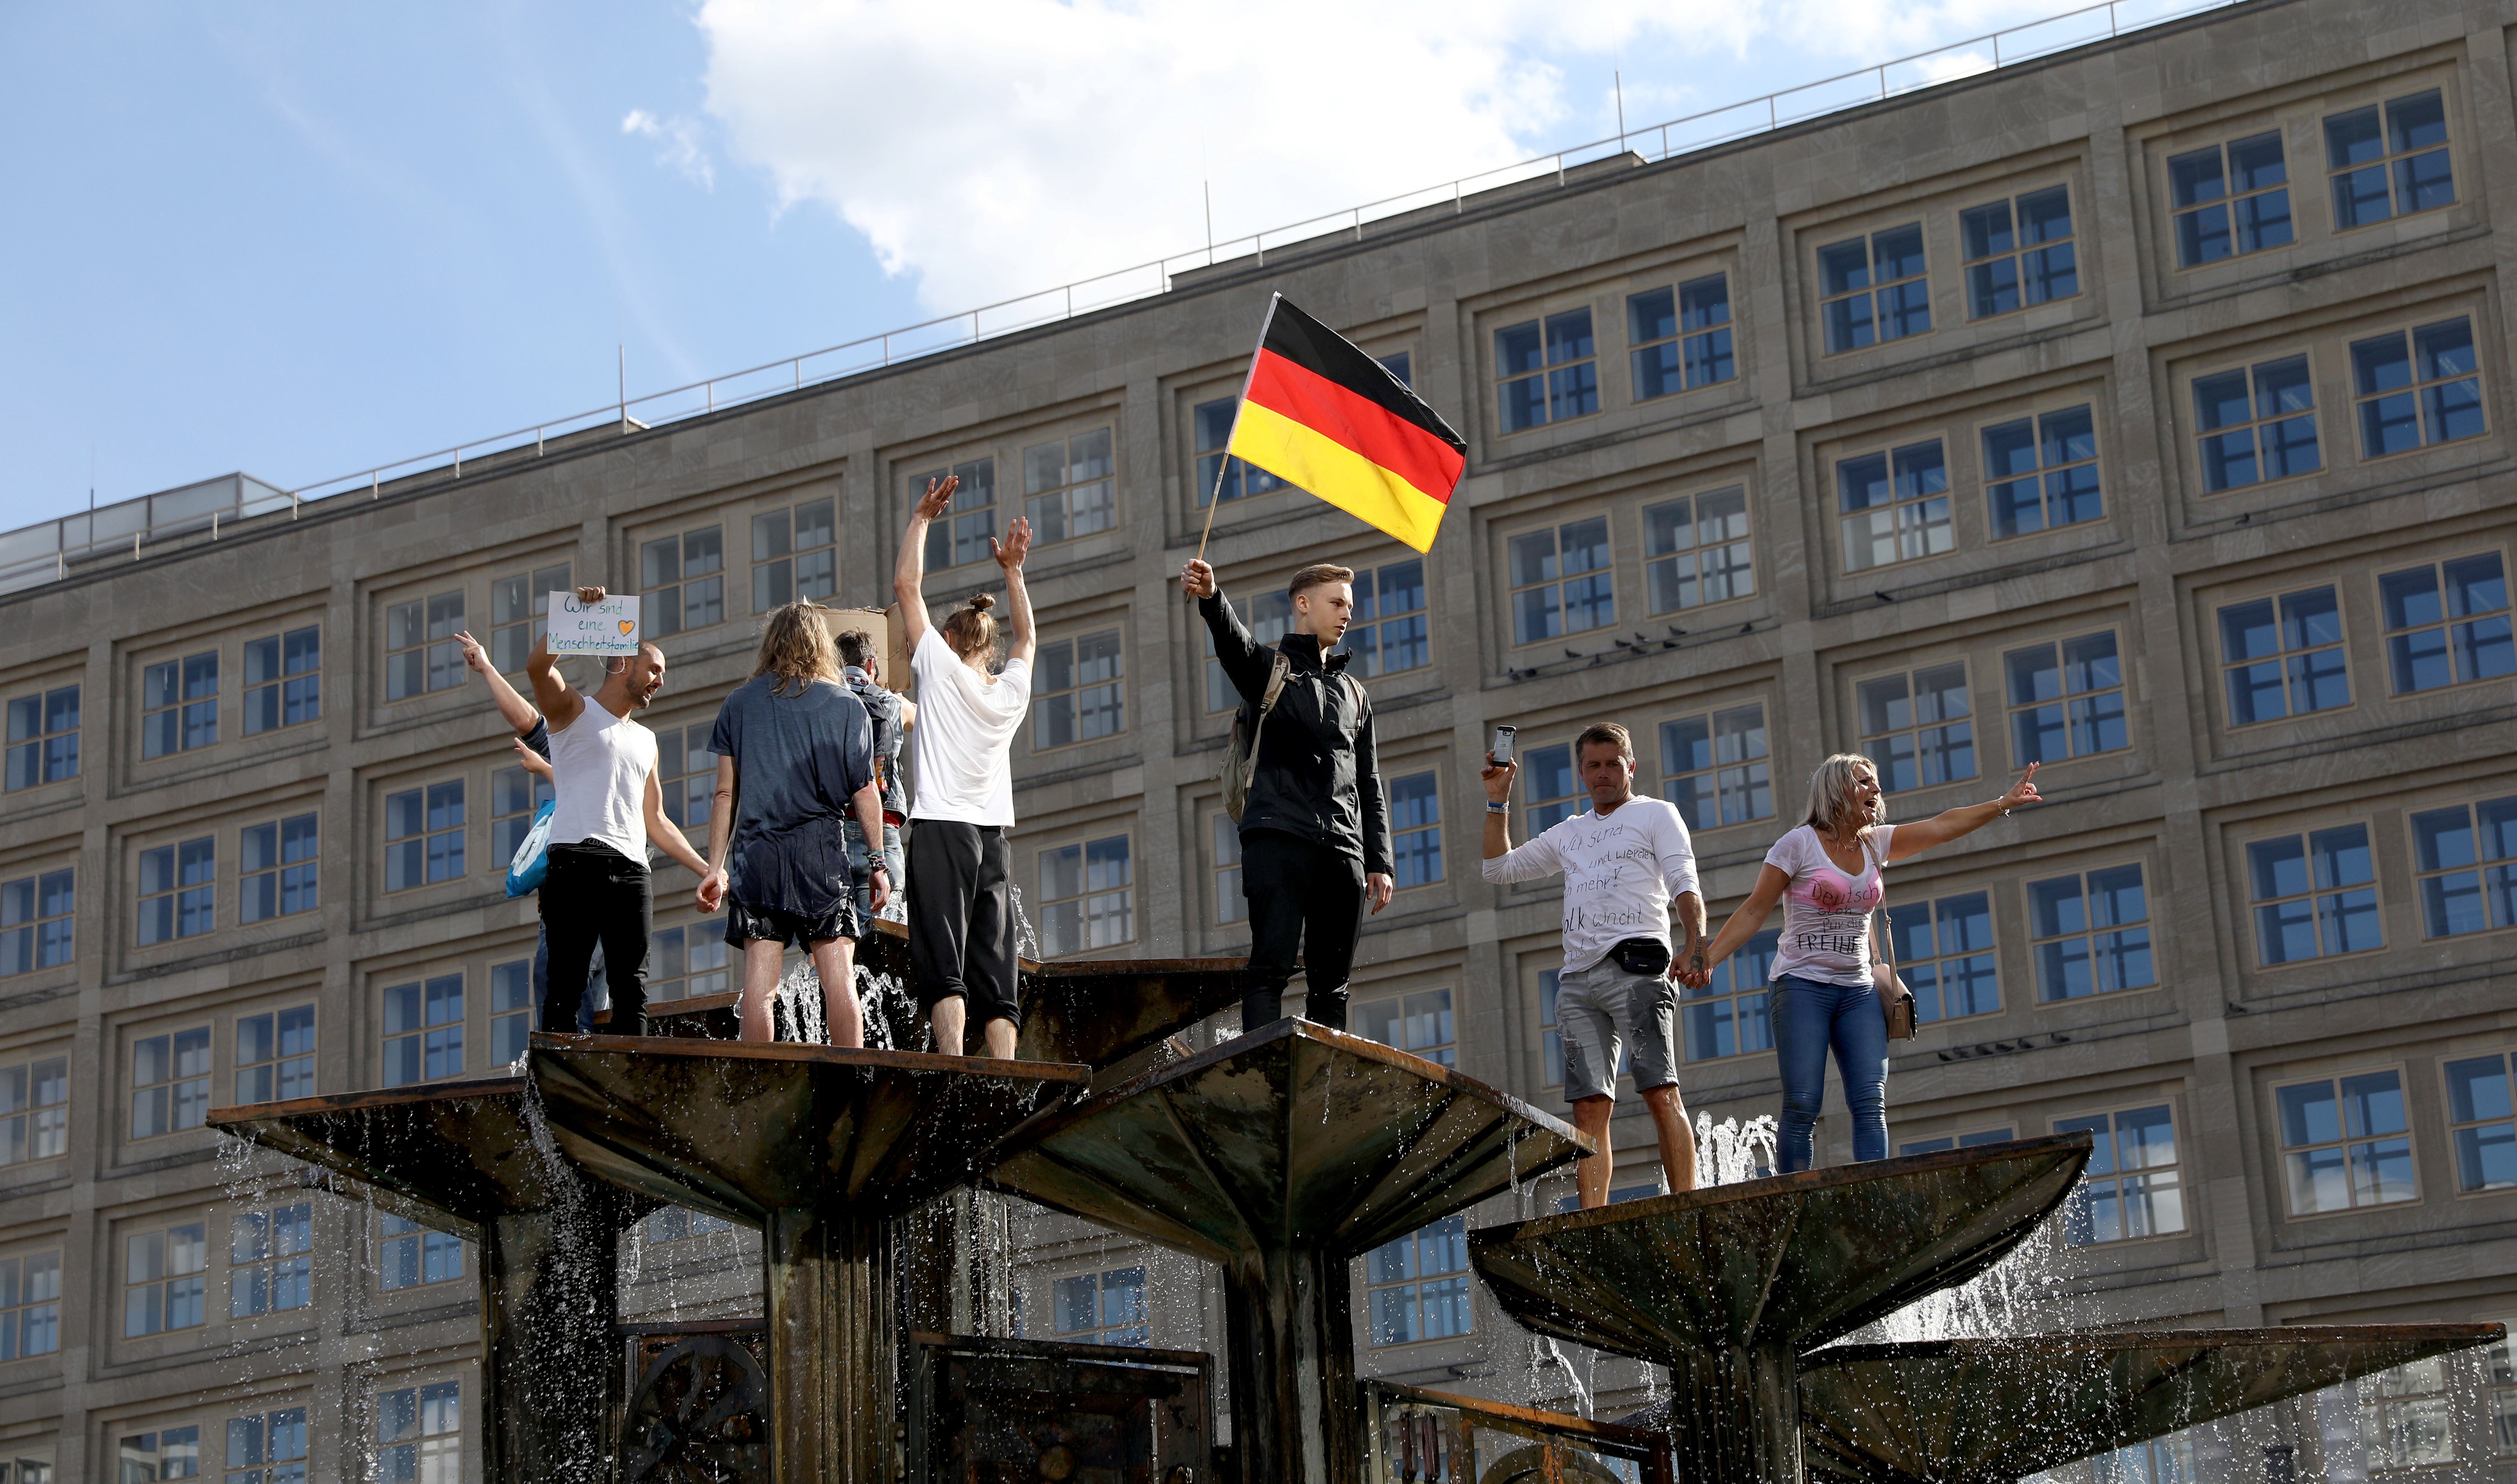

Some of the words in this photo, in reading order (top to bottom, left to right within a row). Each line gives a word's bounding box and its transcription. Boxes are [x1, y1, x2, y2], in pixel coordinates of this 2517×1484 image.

[564, 596, 592, 613] Wir
[596, 599, 623, 616] sind
[578, 618, 606, 631] eine
[548, 633, 639, 653] Menschheitsfamilie
[1589, 851, 1611, 869] und
[1616, 849, 1656, 861] werden
[1809, 879, 1881, 905] Deutsch
[1593, 903, 1643, 927] wacht
[1848, 918, 1864, 928] die
